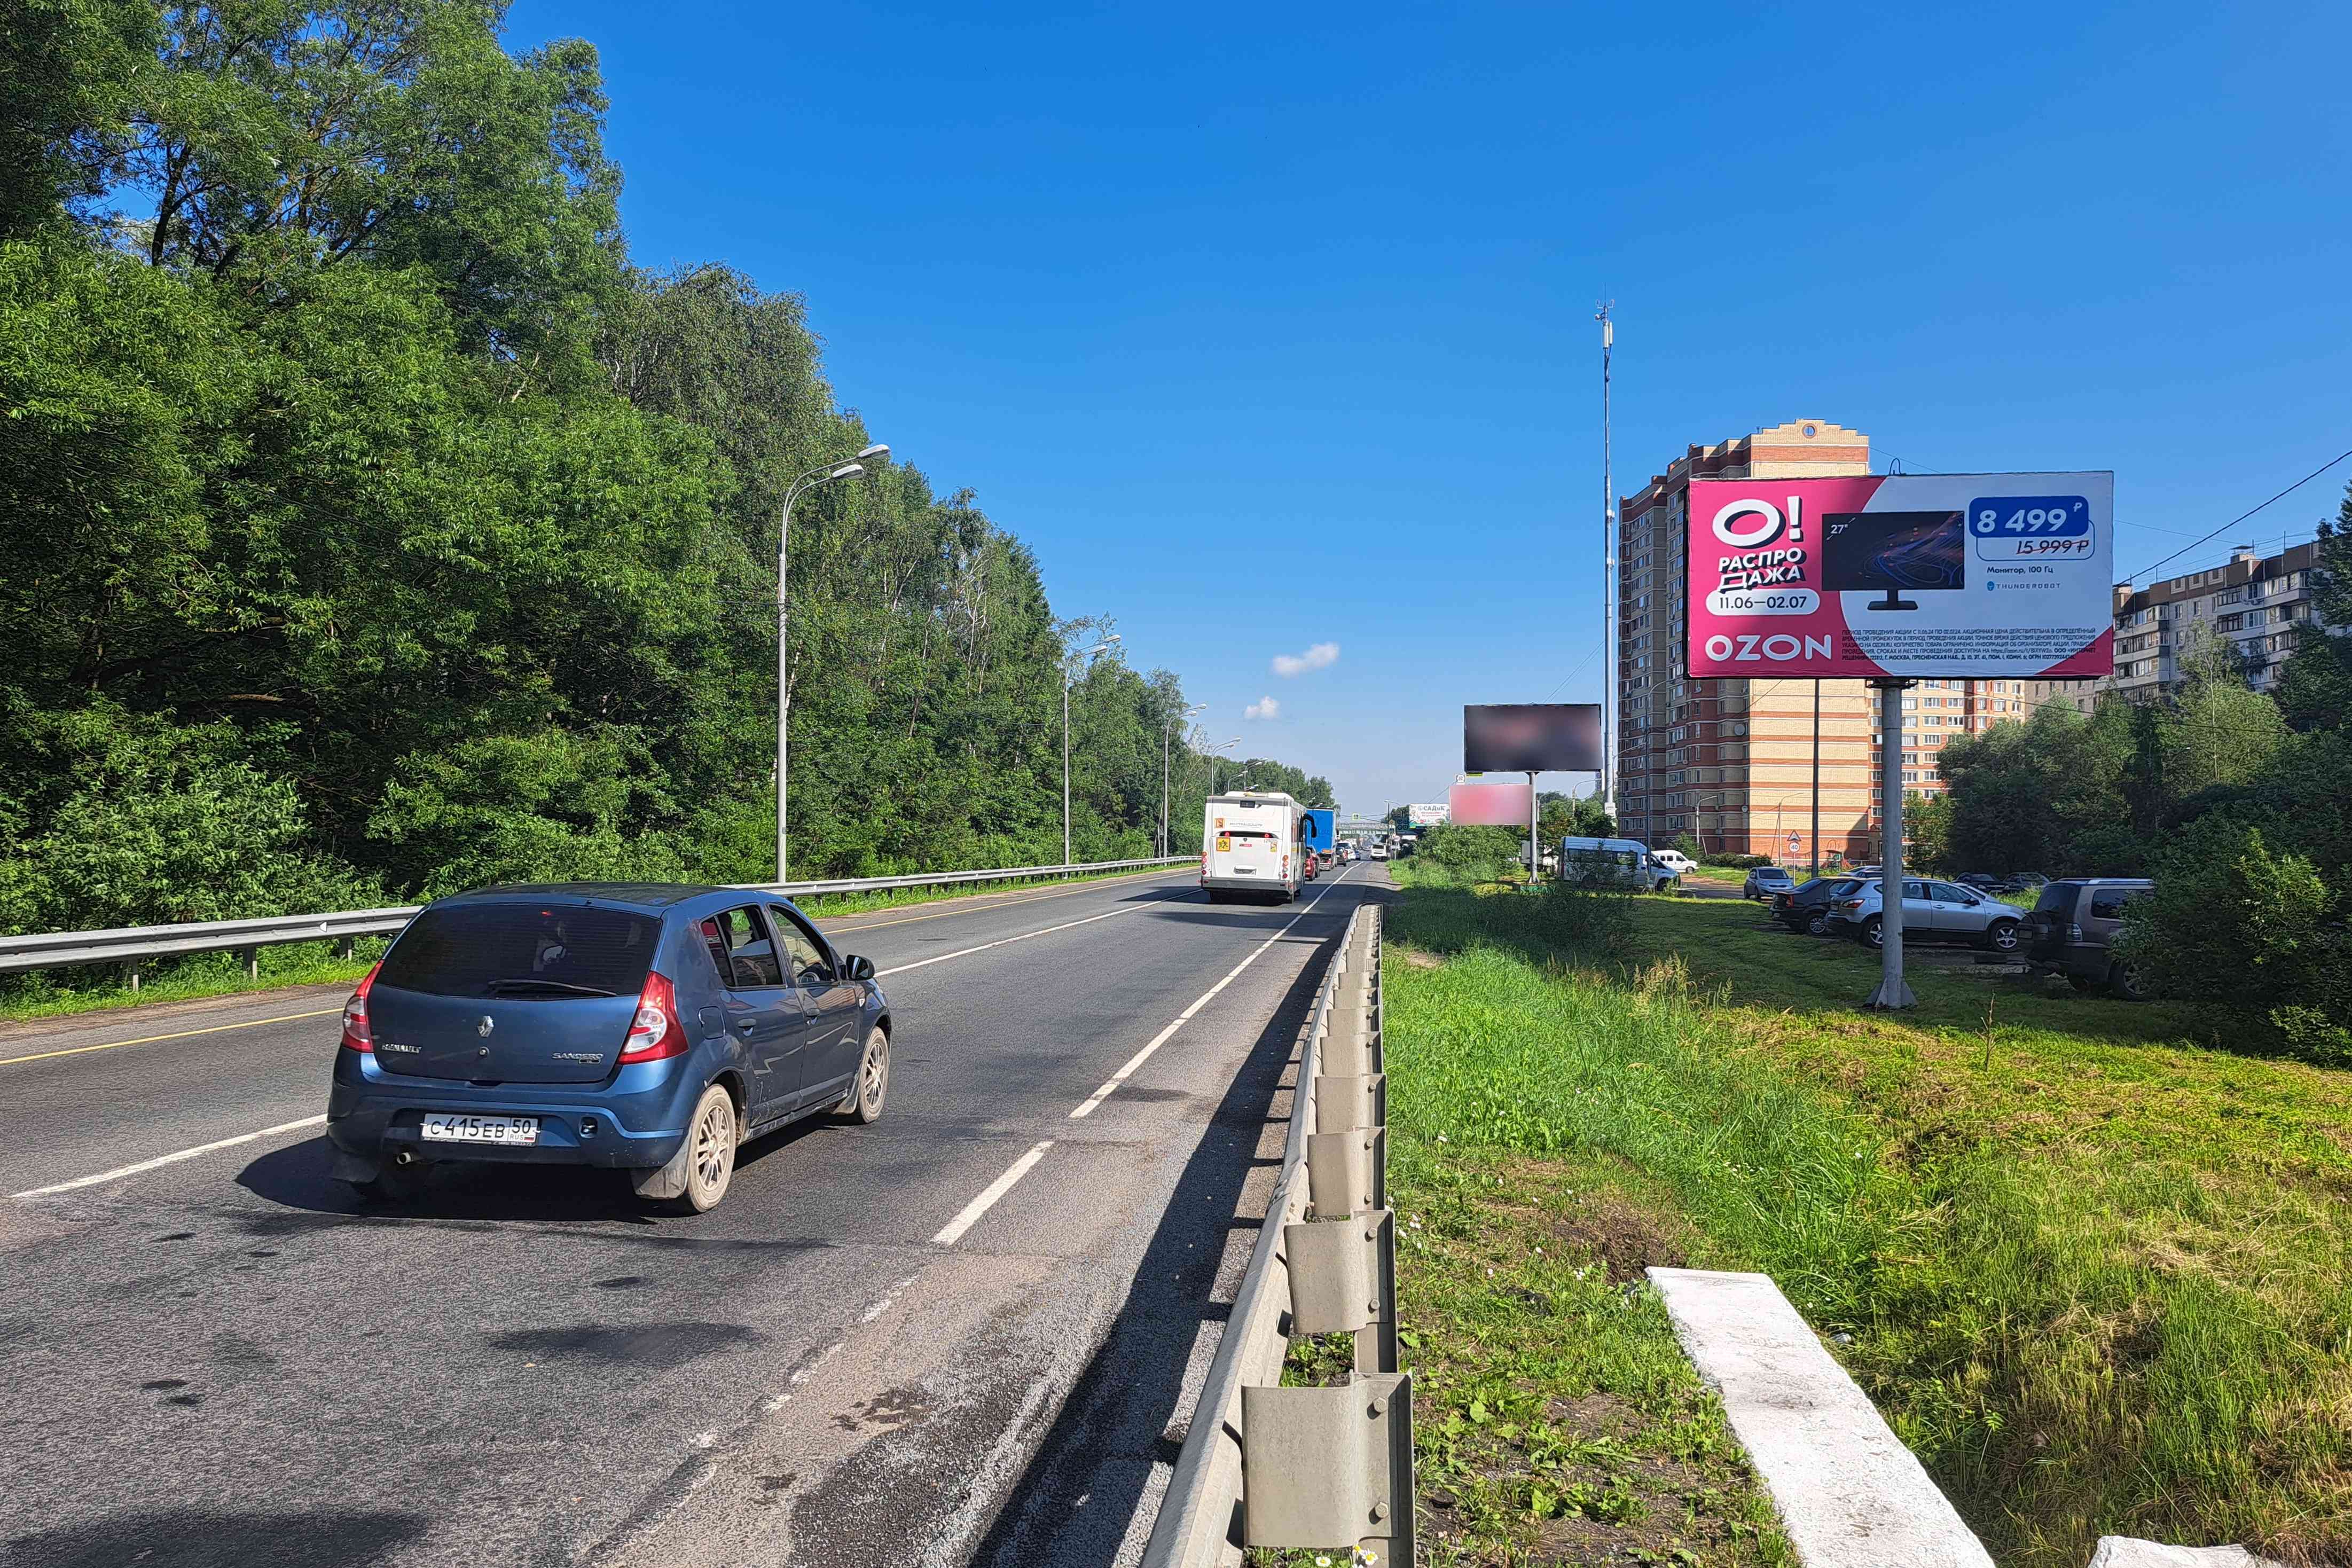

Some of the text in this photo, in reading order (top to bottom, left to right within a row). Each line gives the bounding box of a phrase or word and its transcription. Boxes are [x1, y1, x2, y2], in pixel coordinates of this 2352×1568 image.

[1712, 496, 1804, 549] О!
[1977, 509, 1997, 533] 8
[2005, 508, 2067, 532] 499
[2017, 540, 2034, 554] 15
[2039, 539, 2073, 554] 999
[1718, 547, 1807, 573] РАСПРО
[1986, 566, 2026, 575] Монитор,
[1706, 634, 1831, 661] OZON
[512, 1119, 531, 1134] 50
